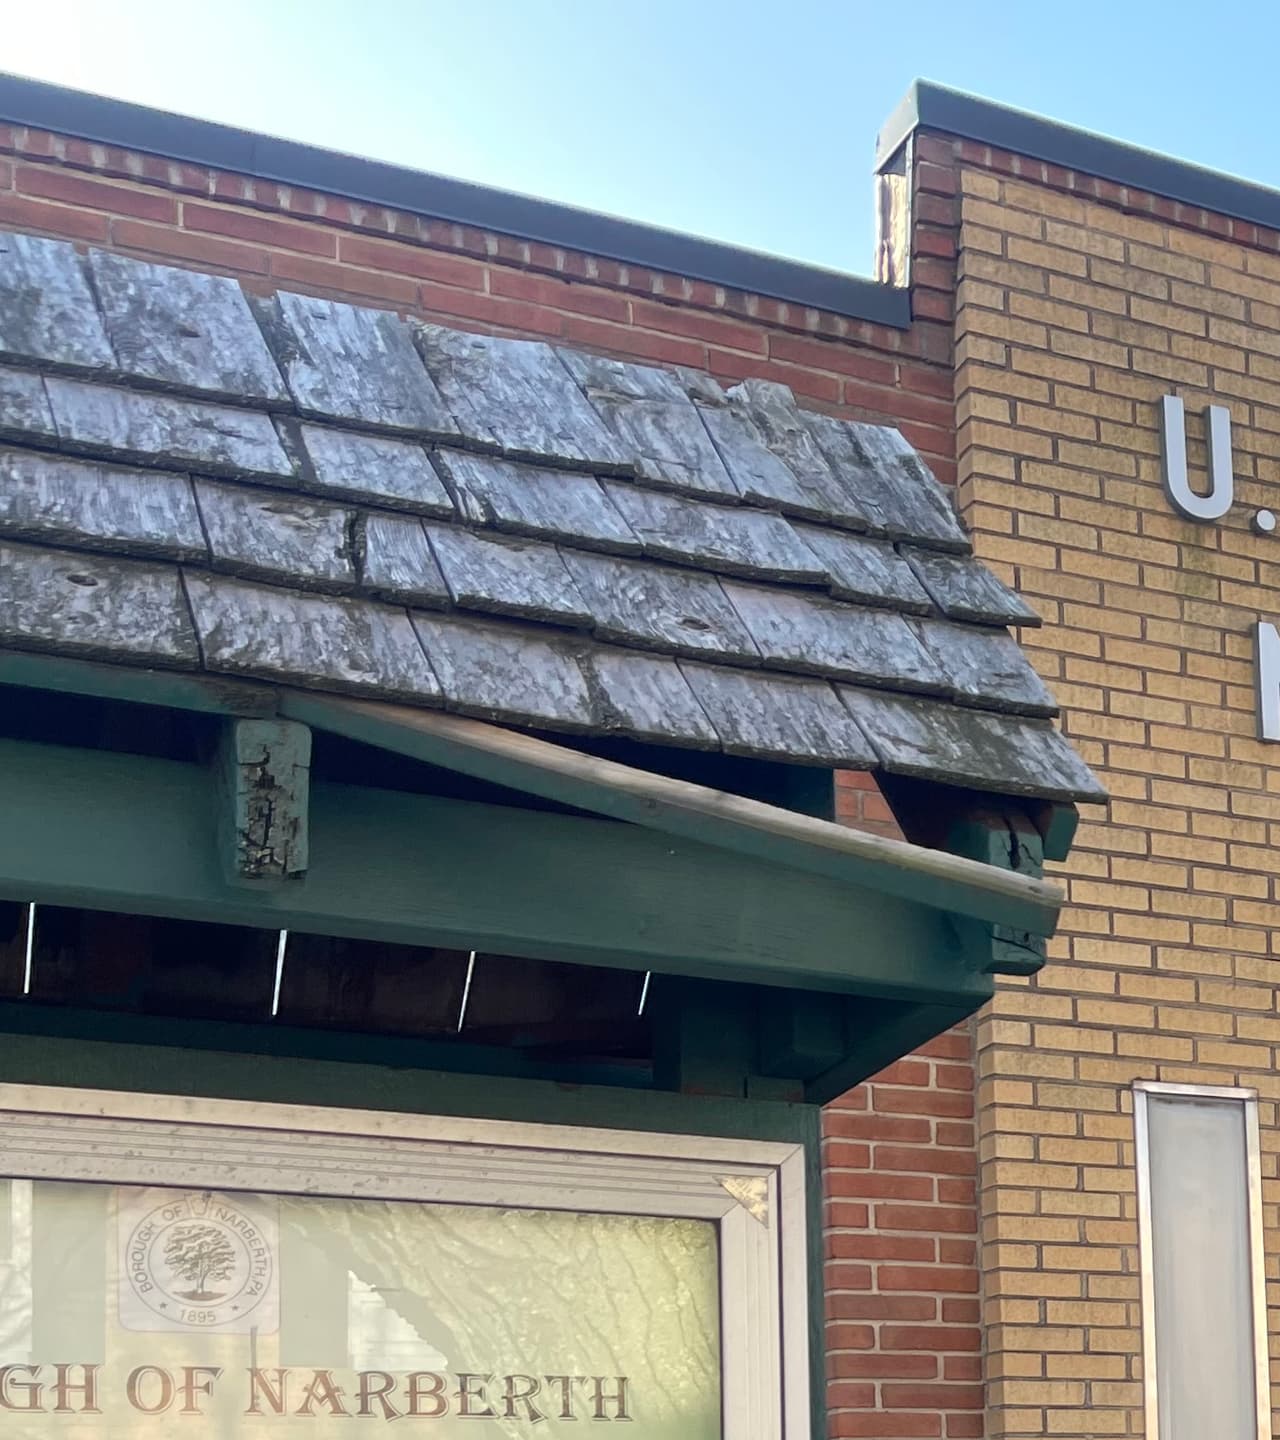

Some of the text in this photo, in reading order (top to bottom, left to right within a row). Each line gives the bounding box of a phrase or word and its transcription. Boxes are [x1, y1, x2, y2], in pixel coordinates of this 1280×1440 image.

[179, 1308, 216, 1323] 1895
[126, 1364, 224, 1416] OF
[245, 1366, 634, 1425] NARBERTH
